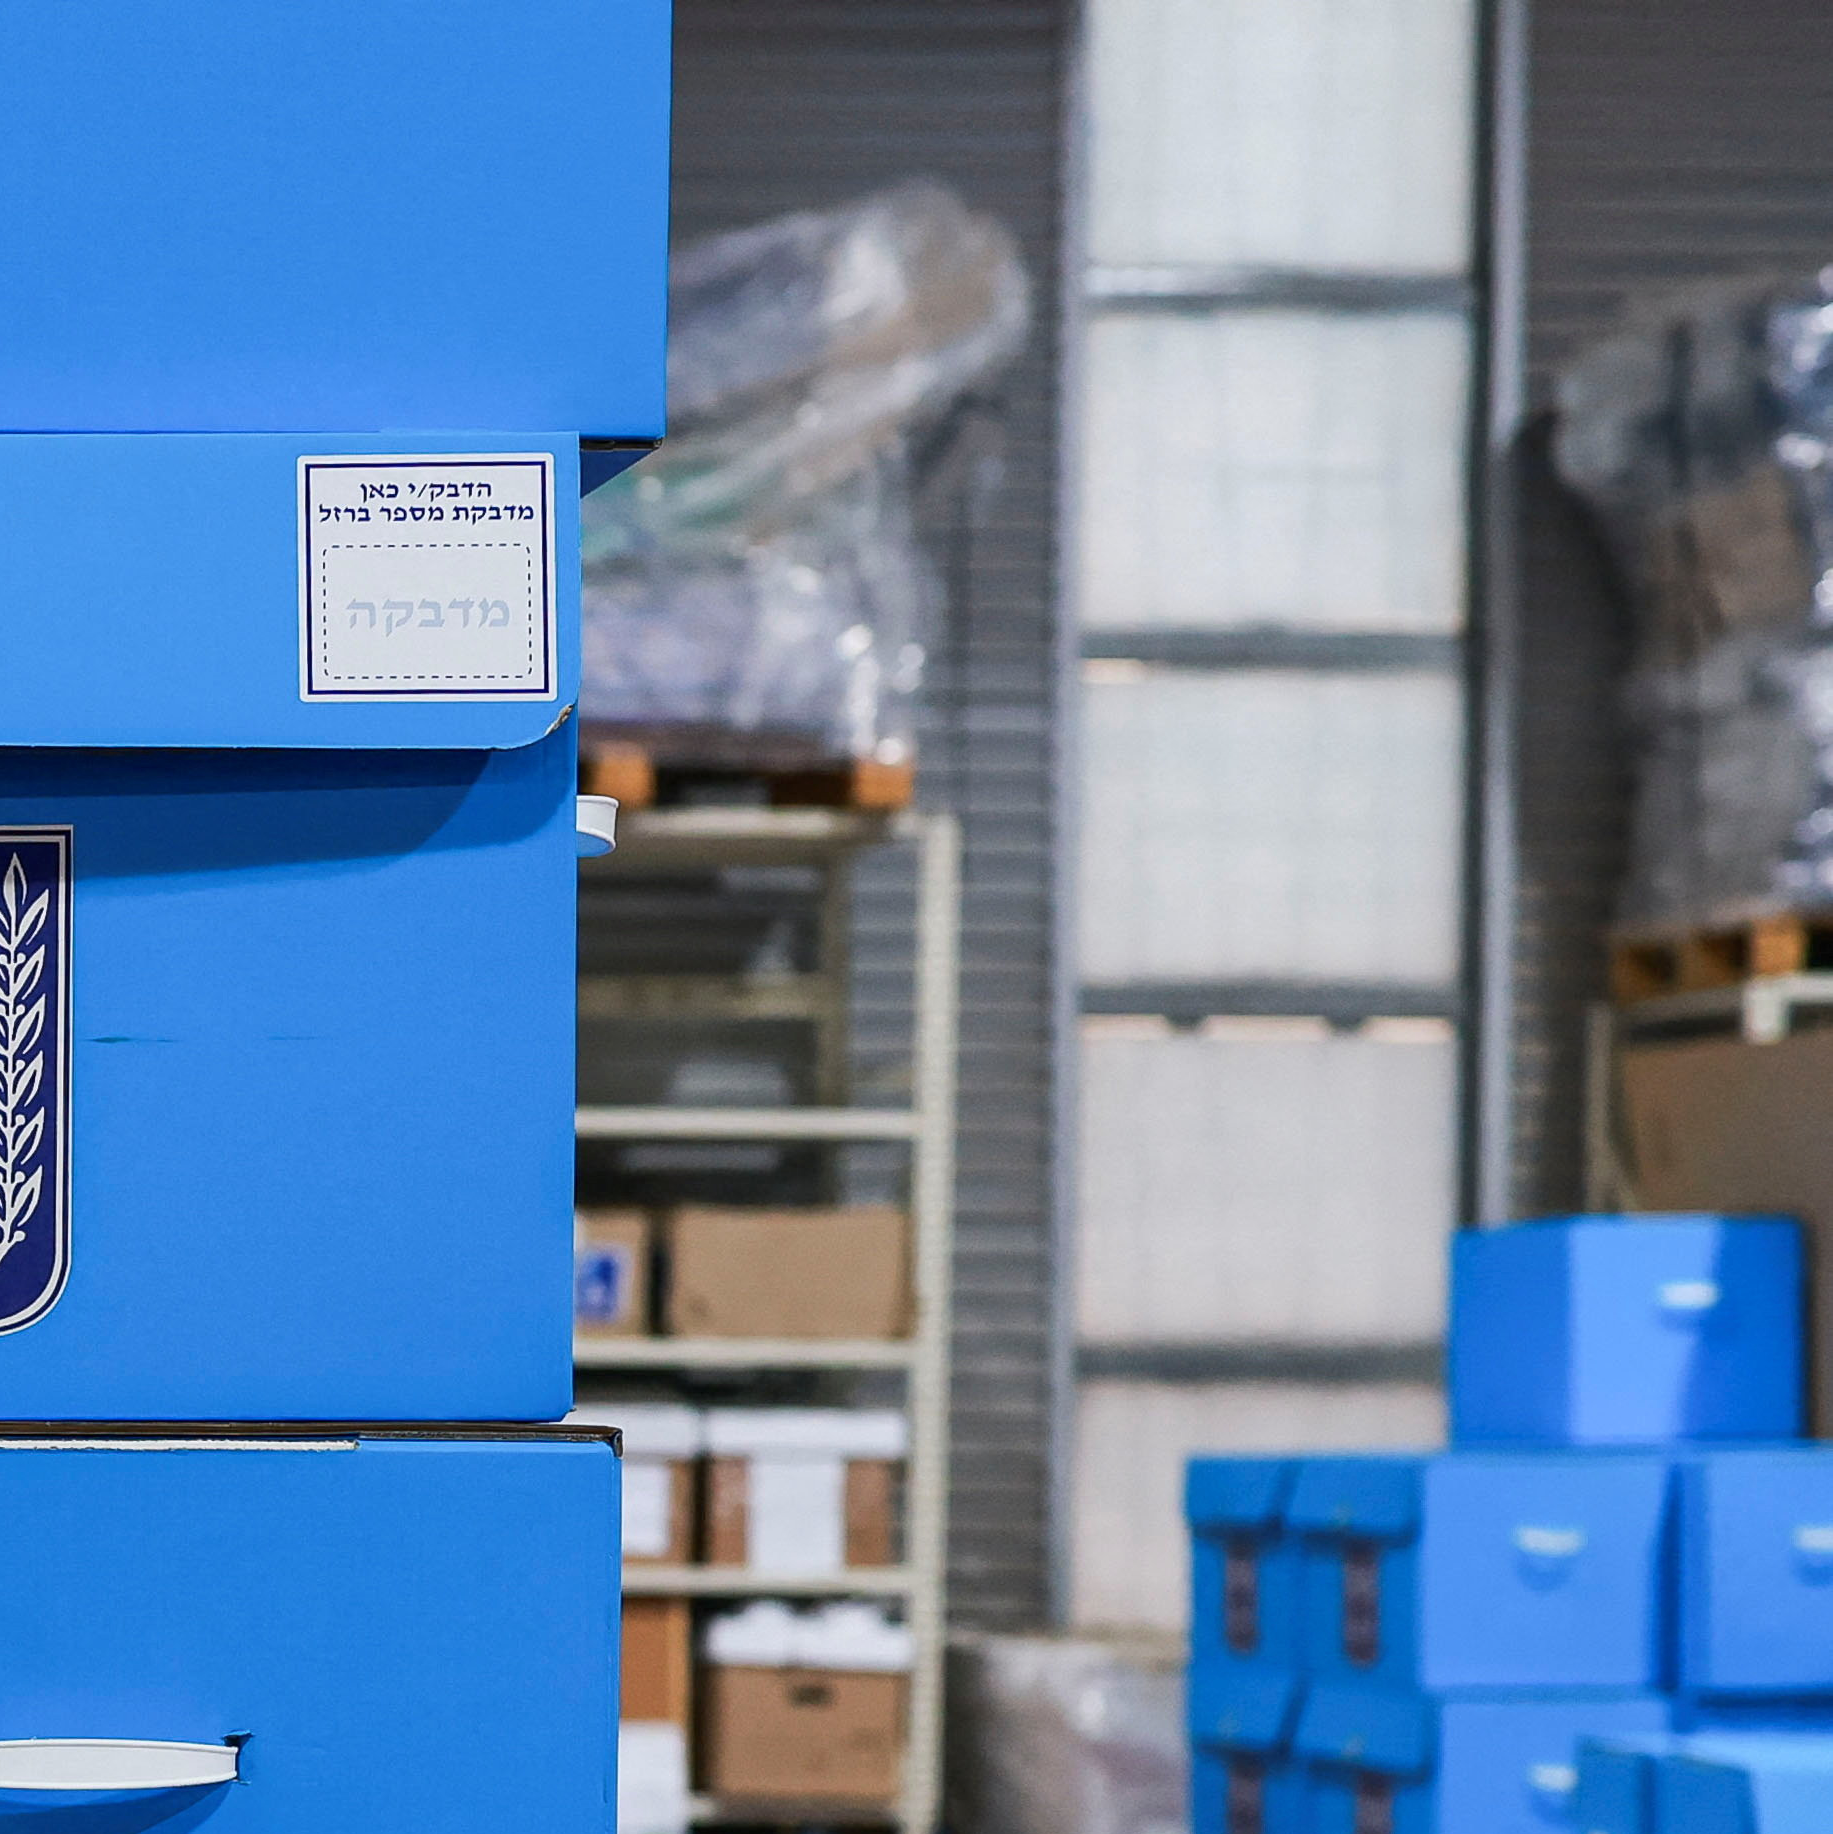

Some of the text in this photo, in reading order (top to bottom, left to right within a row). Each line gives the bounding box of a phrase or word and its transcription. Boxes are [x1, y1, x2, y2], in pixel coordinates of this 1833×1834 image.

[360, 482, 492, 503] הדבק/י כאן
[319, 504, 534, 525] מדבקת מספר ברזל
[345, 598, 510, 637] מדבקה
